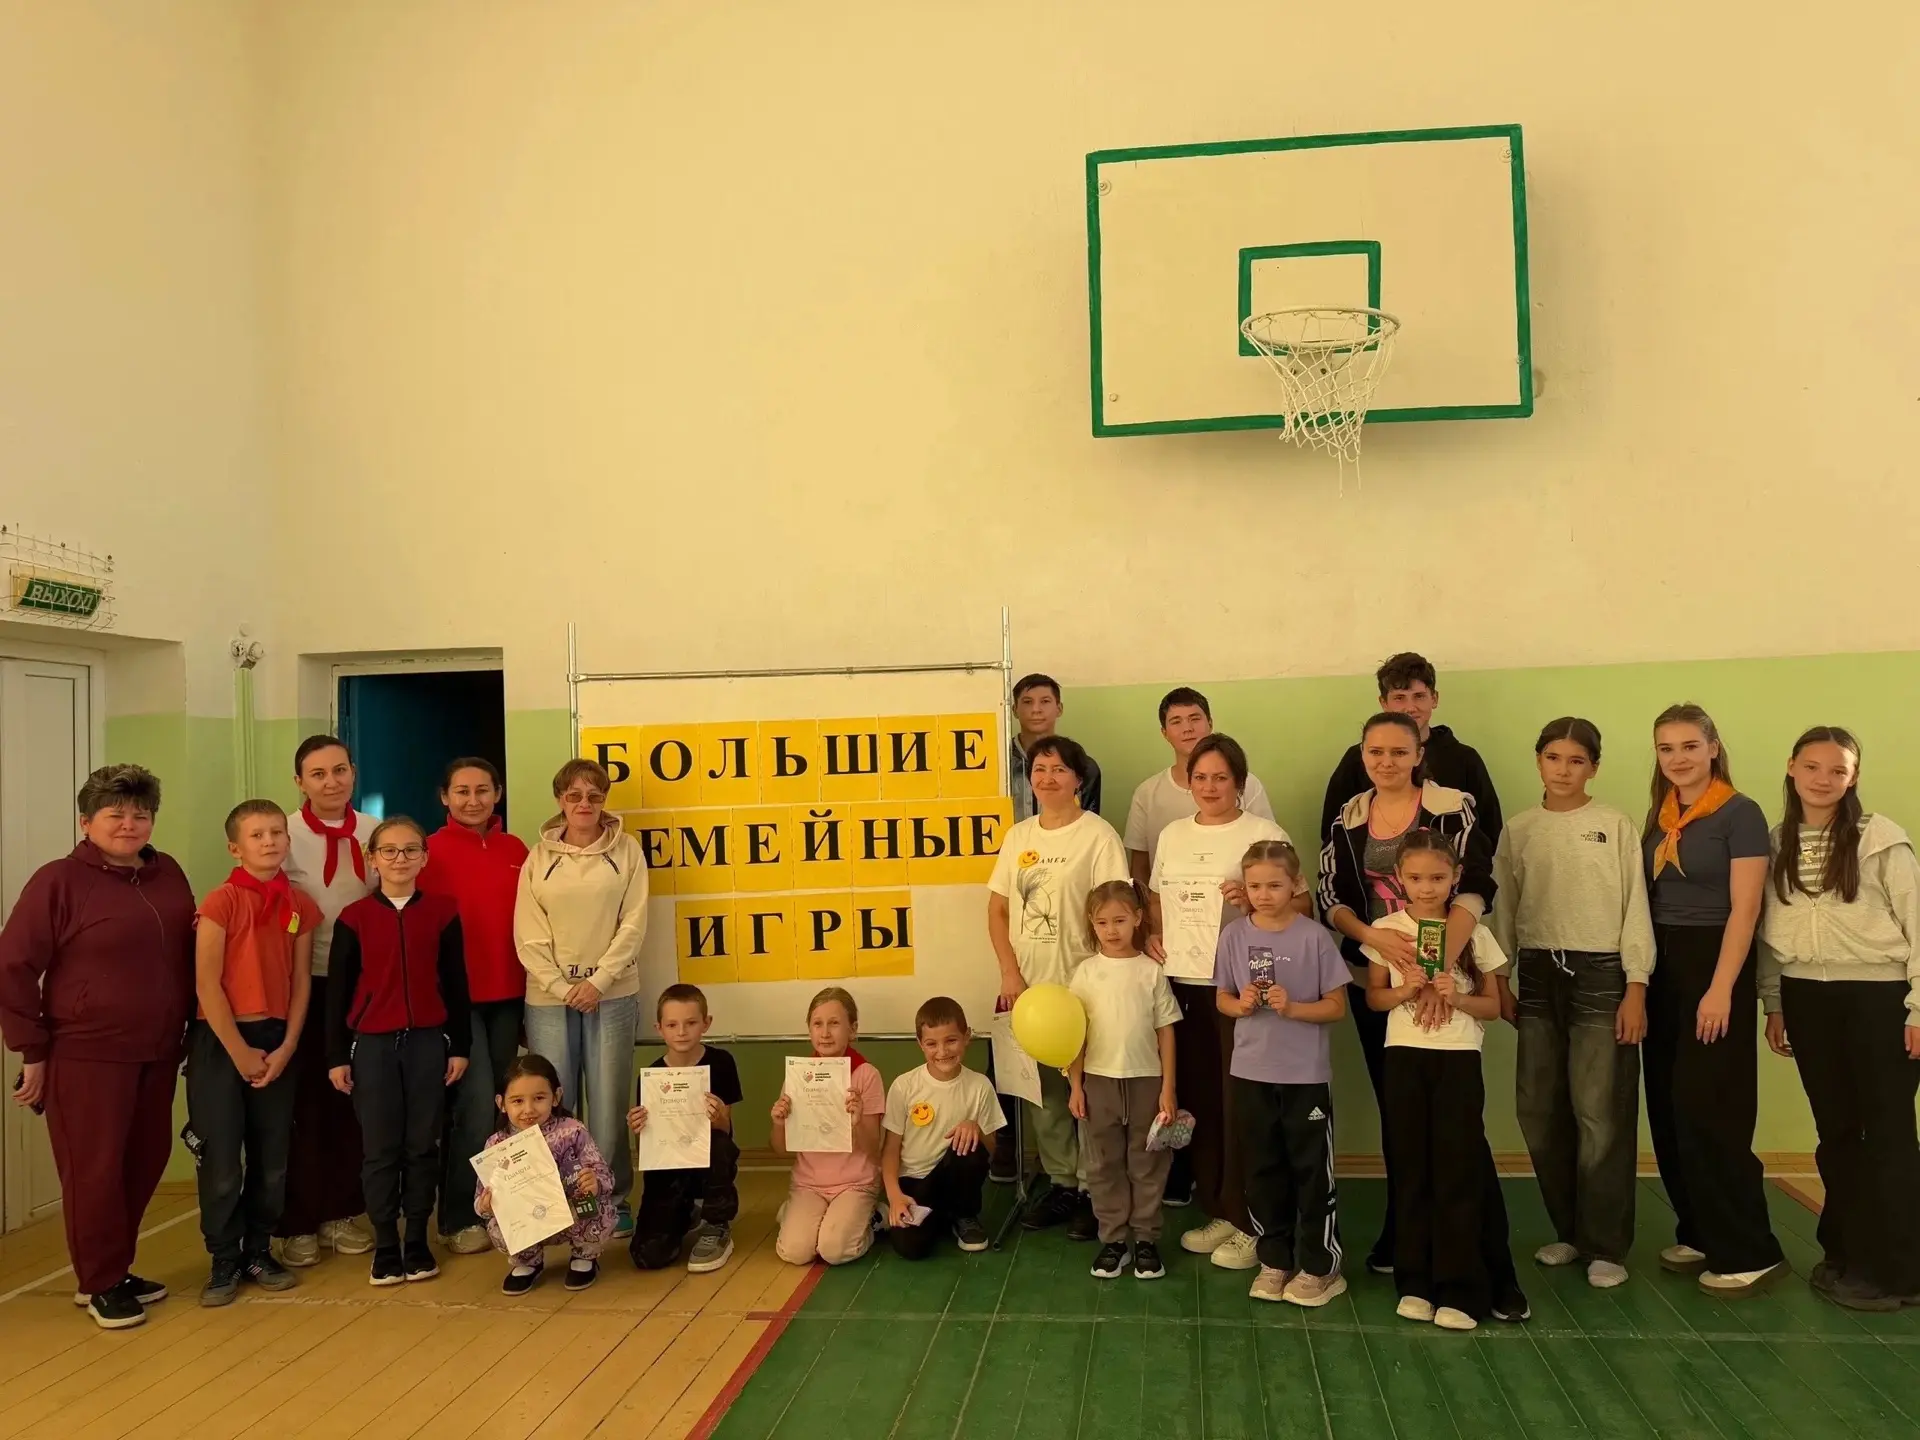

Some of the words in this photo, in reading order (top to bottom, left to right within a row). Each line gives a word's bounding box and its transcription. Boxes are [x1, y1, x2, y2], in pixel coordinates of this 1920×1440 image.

[29, 585, 95, 612] ВЫХОД
[592, 729, 987, 783] БОЛЬШИЕ
[636, 808, 1001, 869] ЕМЕЙНЫЕ
[684, 906, 913, 958] ИГРЫ
[1248, 958, 1273, 970] Milka
